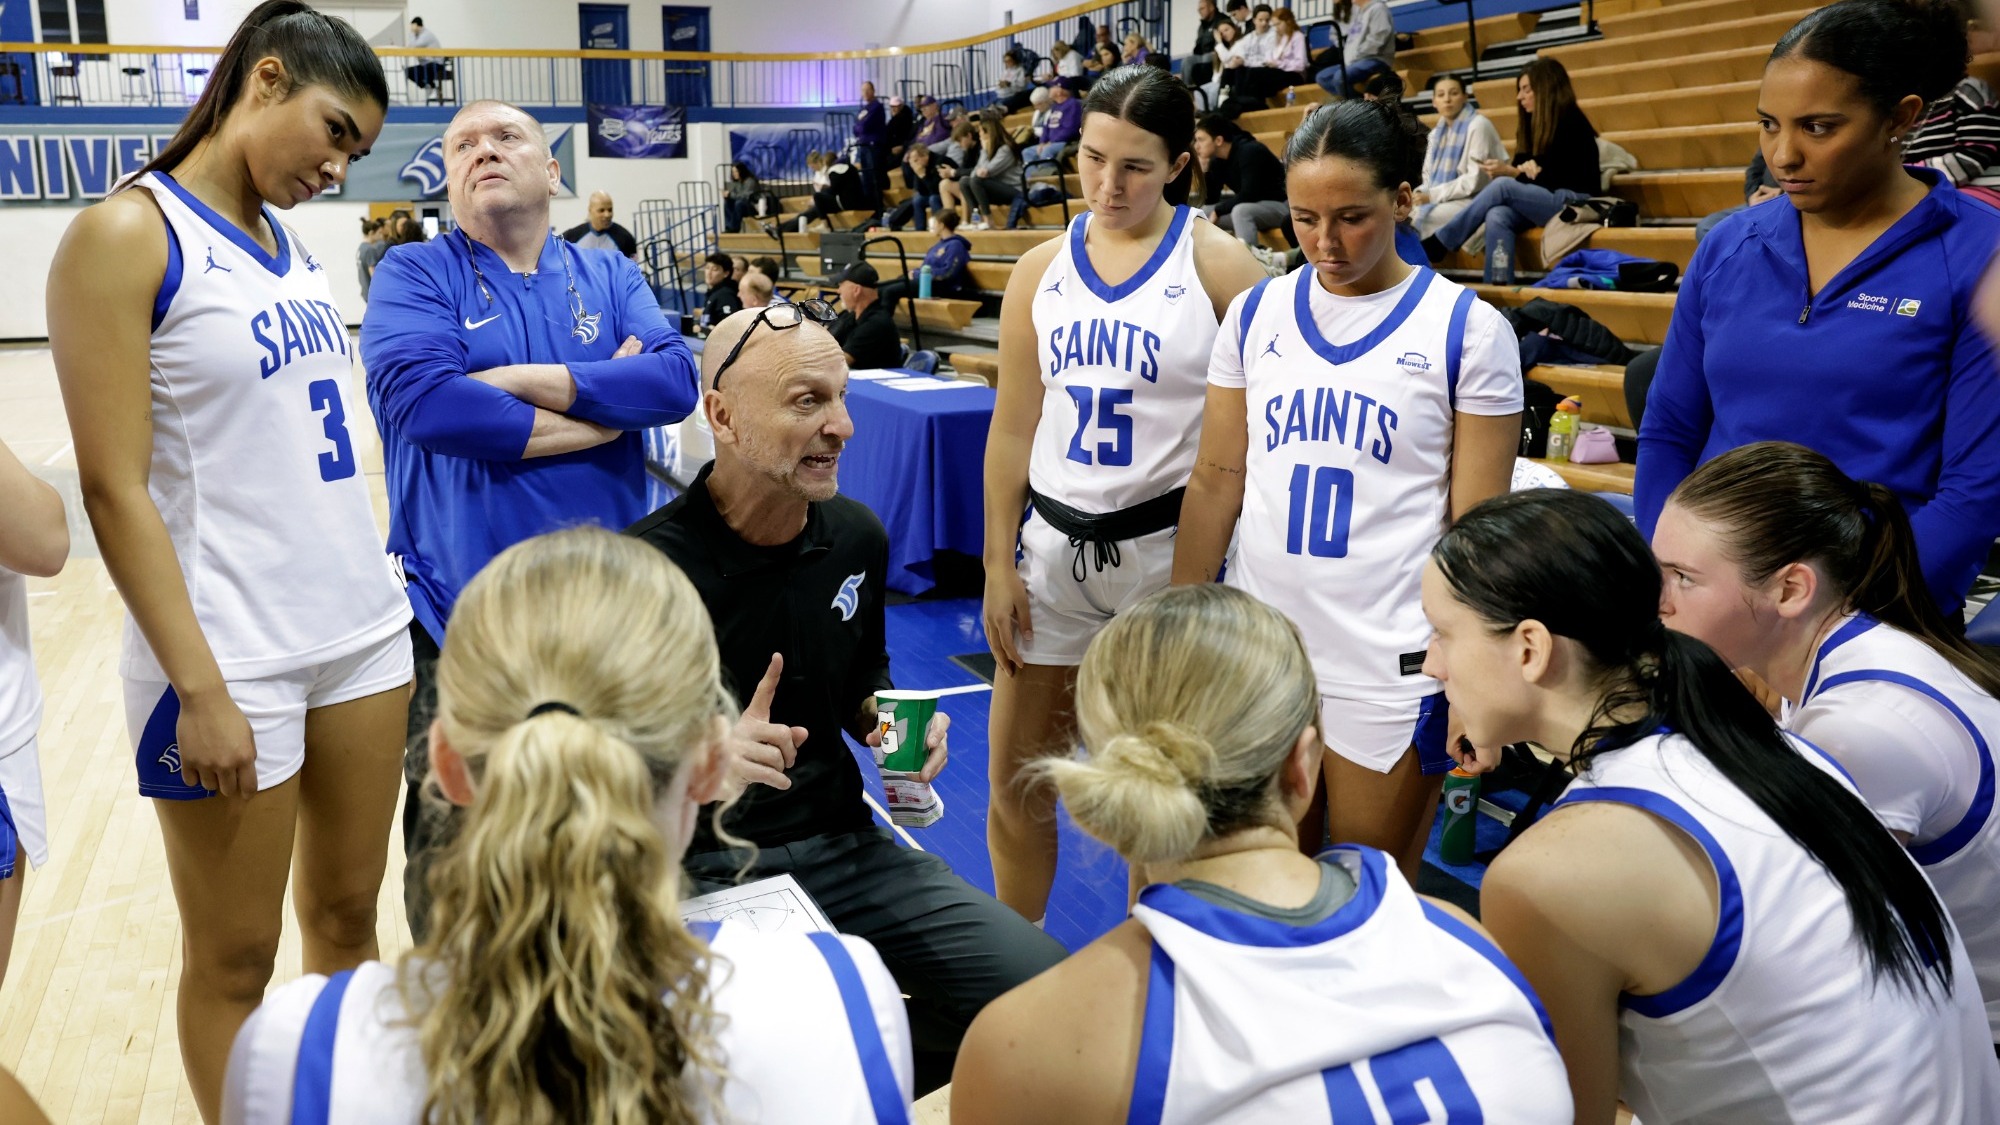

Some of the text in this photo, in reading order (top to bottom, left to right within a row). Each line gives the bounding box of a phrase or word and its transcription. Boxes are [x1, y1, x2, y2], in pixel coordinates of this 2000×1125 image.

[0, 134, 178, 200] NIVE
[1847, 300, 1885, 312] Medicine
[1858, 292, 1888, 305] Sports
[1050, 318, 1161, 383] SAINTS
[308, 378, 356, 482] 3
[1065, 385, 1134, 466] 25
[1265, 387, 1398, 465] SAINTS
[1551, 434, 1561, 447] G
[1287, 463, 1354, 559] 10
[877, 710, 899, 754] G
[1447, 789, 1471, 815] G
